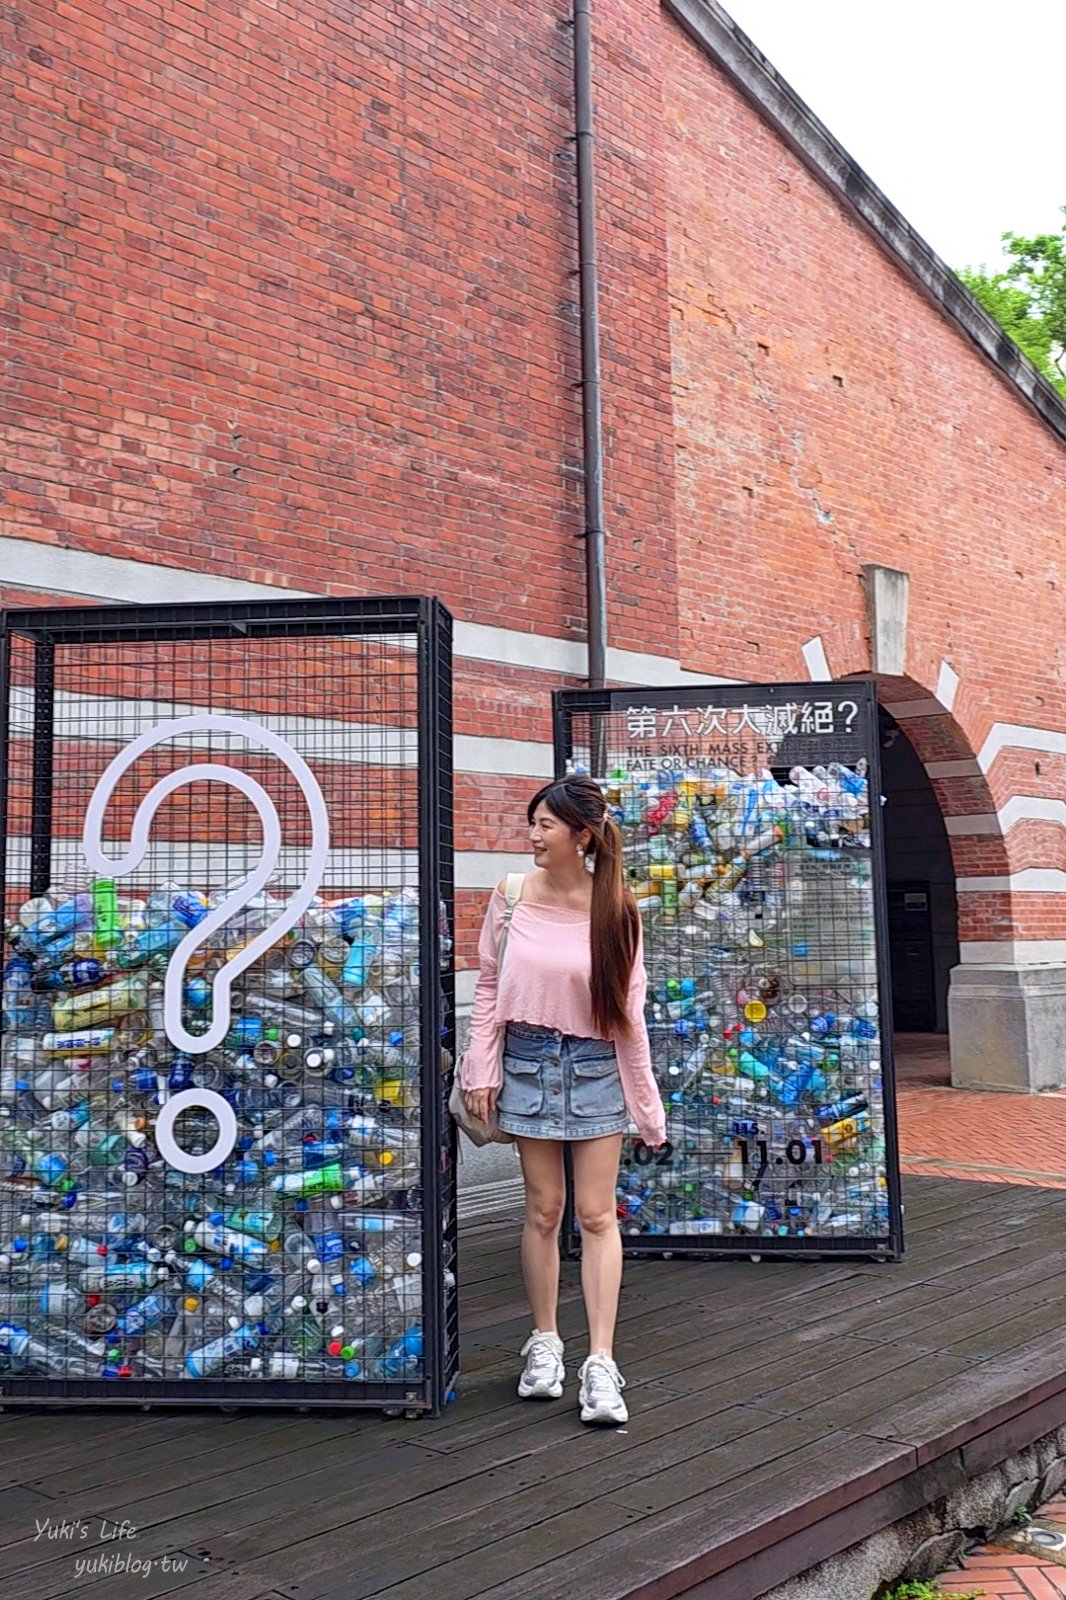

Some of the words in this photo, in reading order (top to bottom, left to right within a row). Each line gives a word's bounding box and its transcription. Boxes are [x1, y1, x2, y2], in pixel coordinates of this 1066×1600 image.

[626, 745, 652, 757] THE
[660, 743, 699, 756] SIXTH
[708, 742, 749, 755] MASS
[626, 758, 657, 771] FATE
[661, 757, 682, 770] OR
[686, 755, 746, 770] CHANCE
[737, 1139, 823, 1165] 11.01
